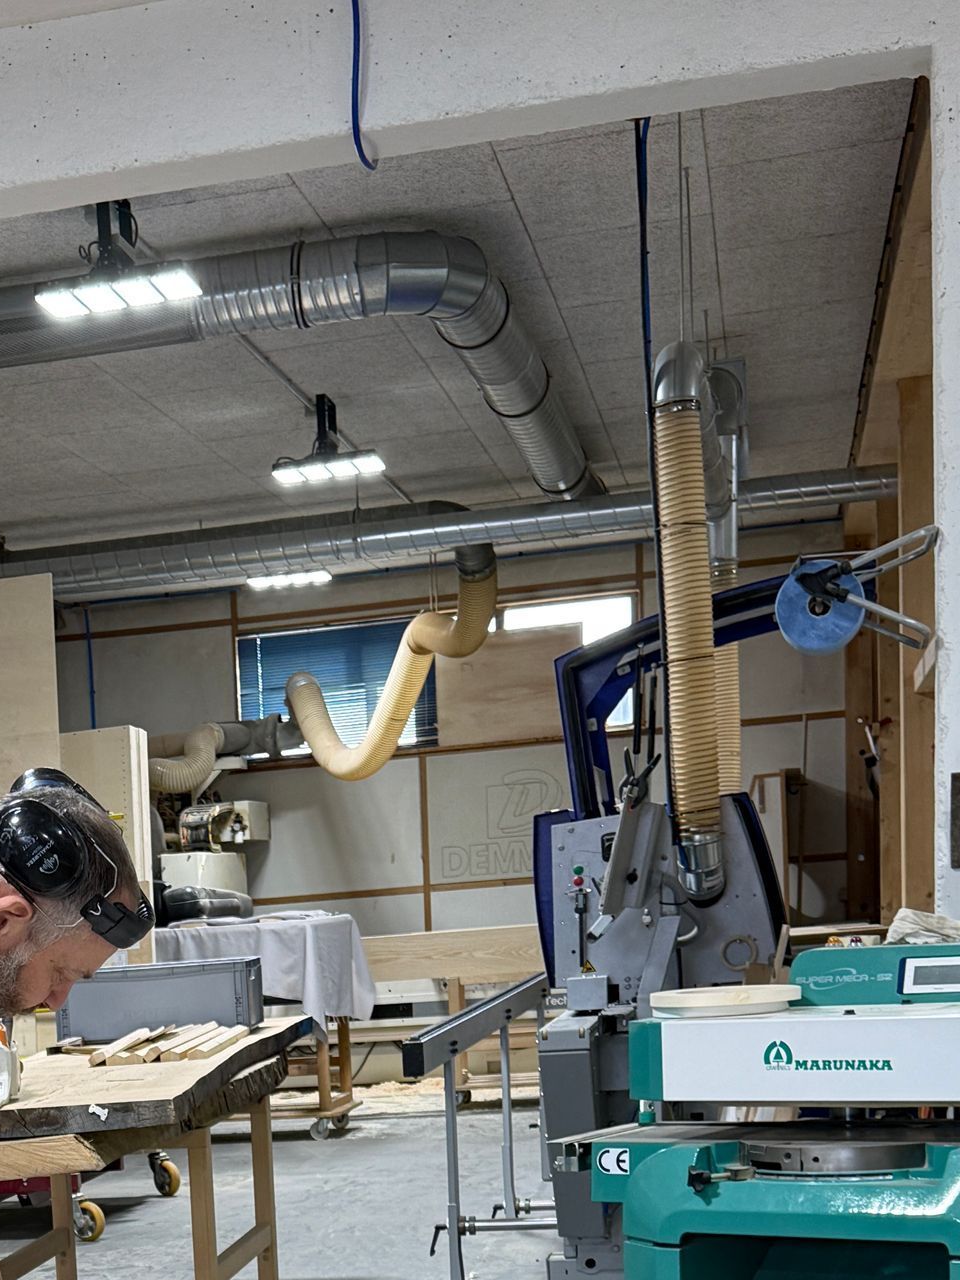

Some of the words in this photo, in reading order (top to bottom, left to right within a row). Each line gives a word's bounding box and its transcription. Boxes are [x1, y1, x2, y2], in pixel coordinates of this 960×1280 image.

[795, 975, 833, 984] SUPER
[794, 1060, 893, 1071] MARUNAKA
[598, 1149, 629, 1173] CE
